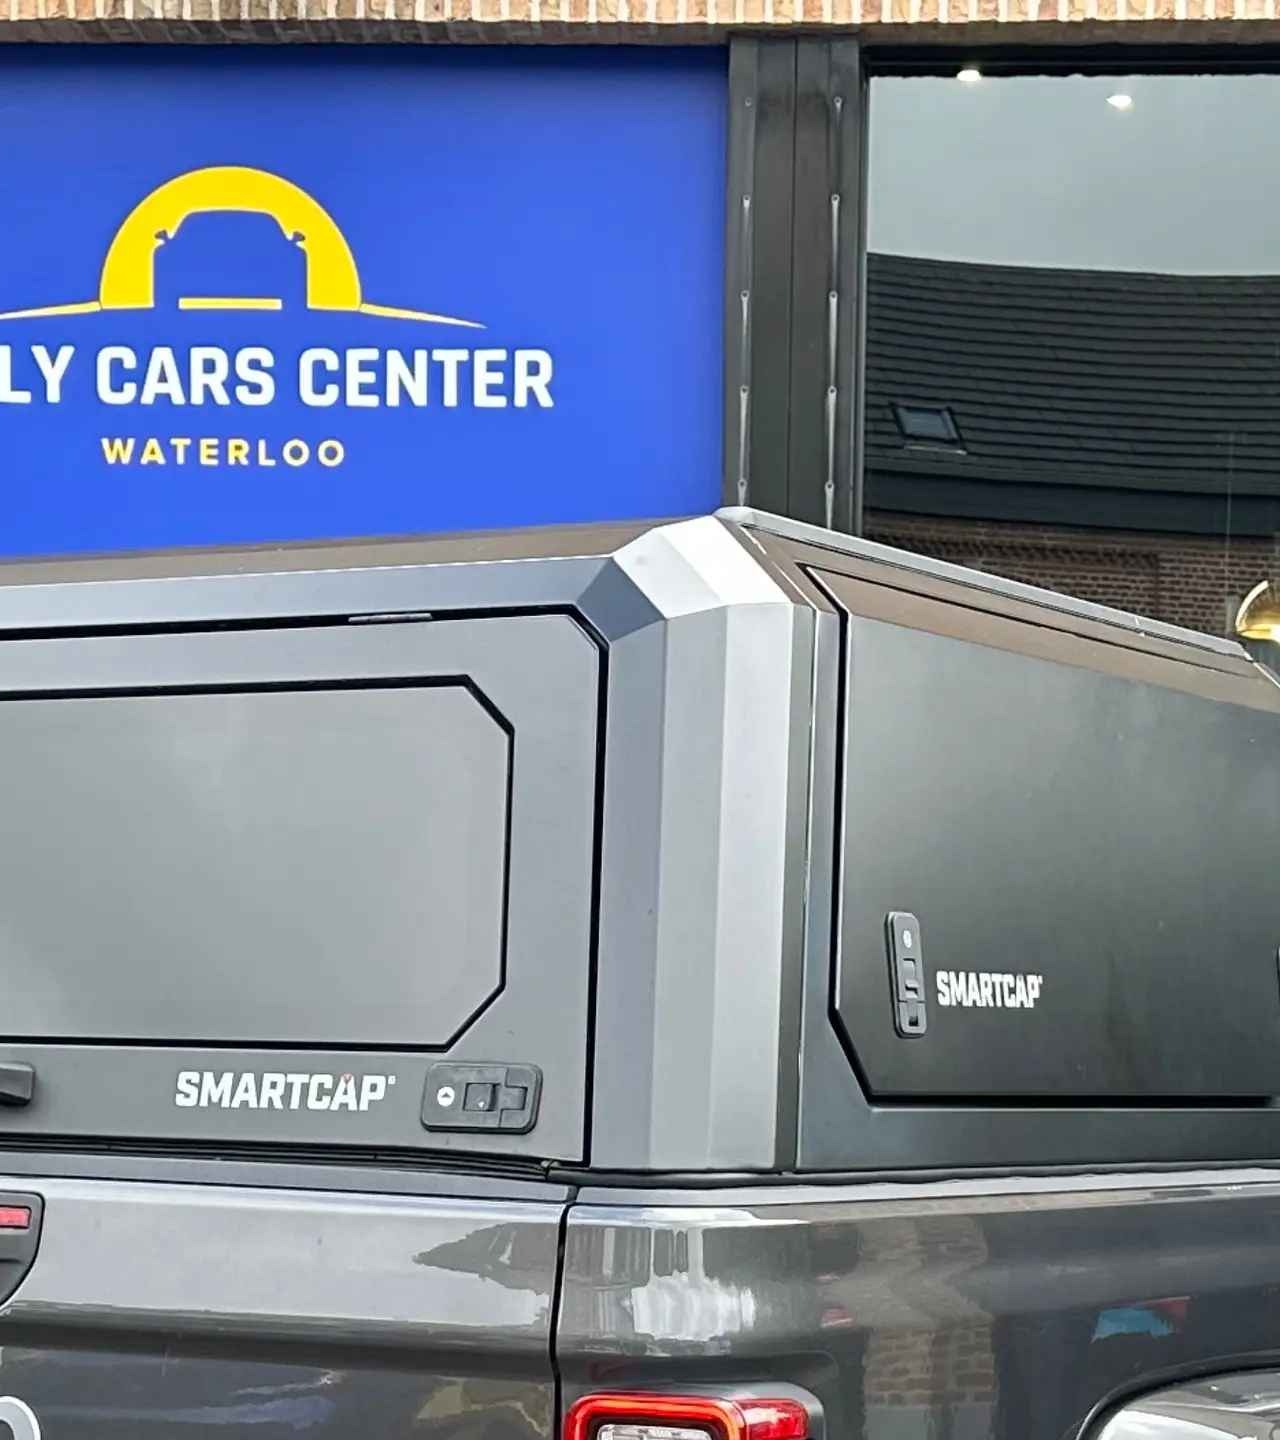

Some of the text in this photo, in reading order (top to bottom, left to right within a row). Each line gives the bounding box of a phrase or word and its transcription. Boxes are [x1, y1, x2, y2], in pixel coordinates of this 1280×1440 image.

[95, 346, 276, 405] CARS
[298, 347, 553, 408] CENTER
[101, 437, 345, 467] WATERLOO
